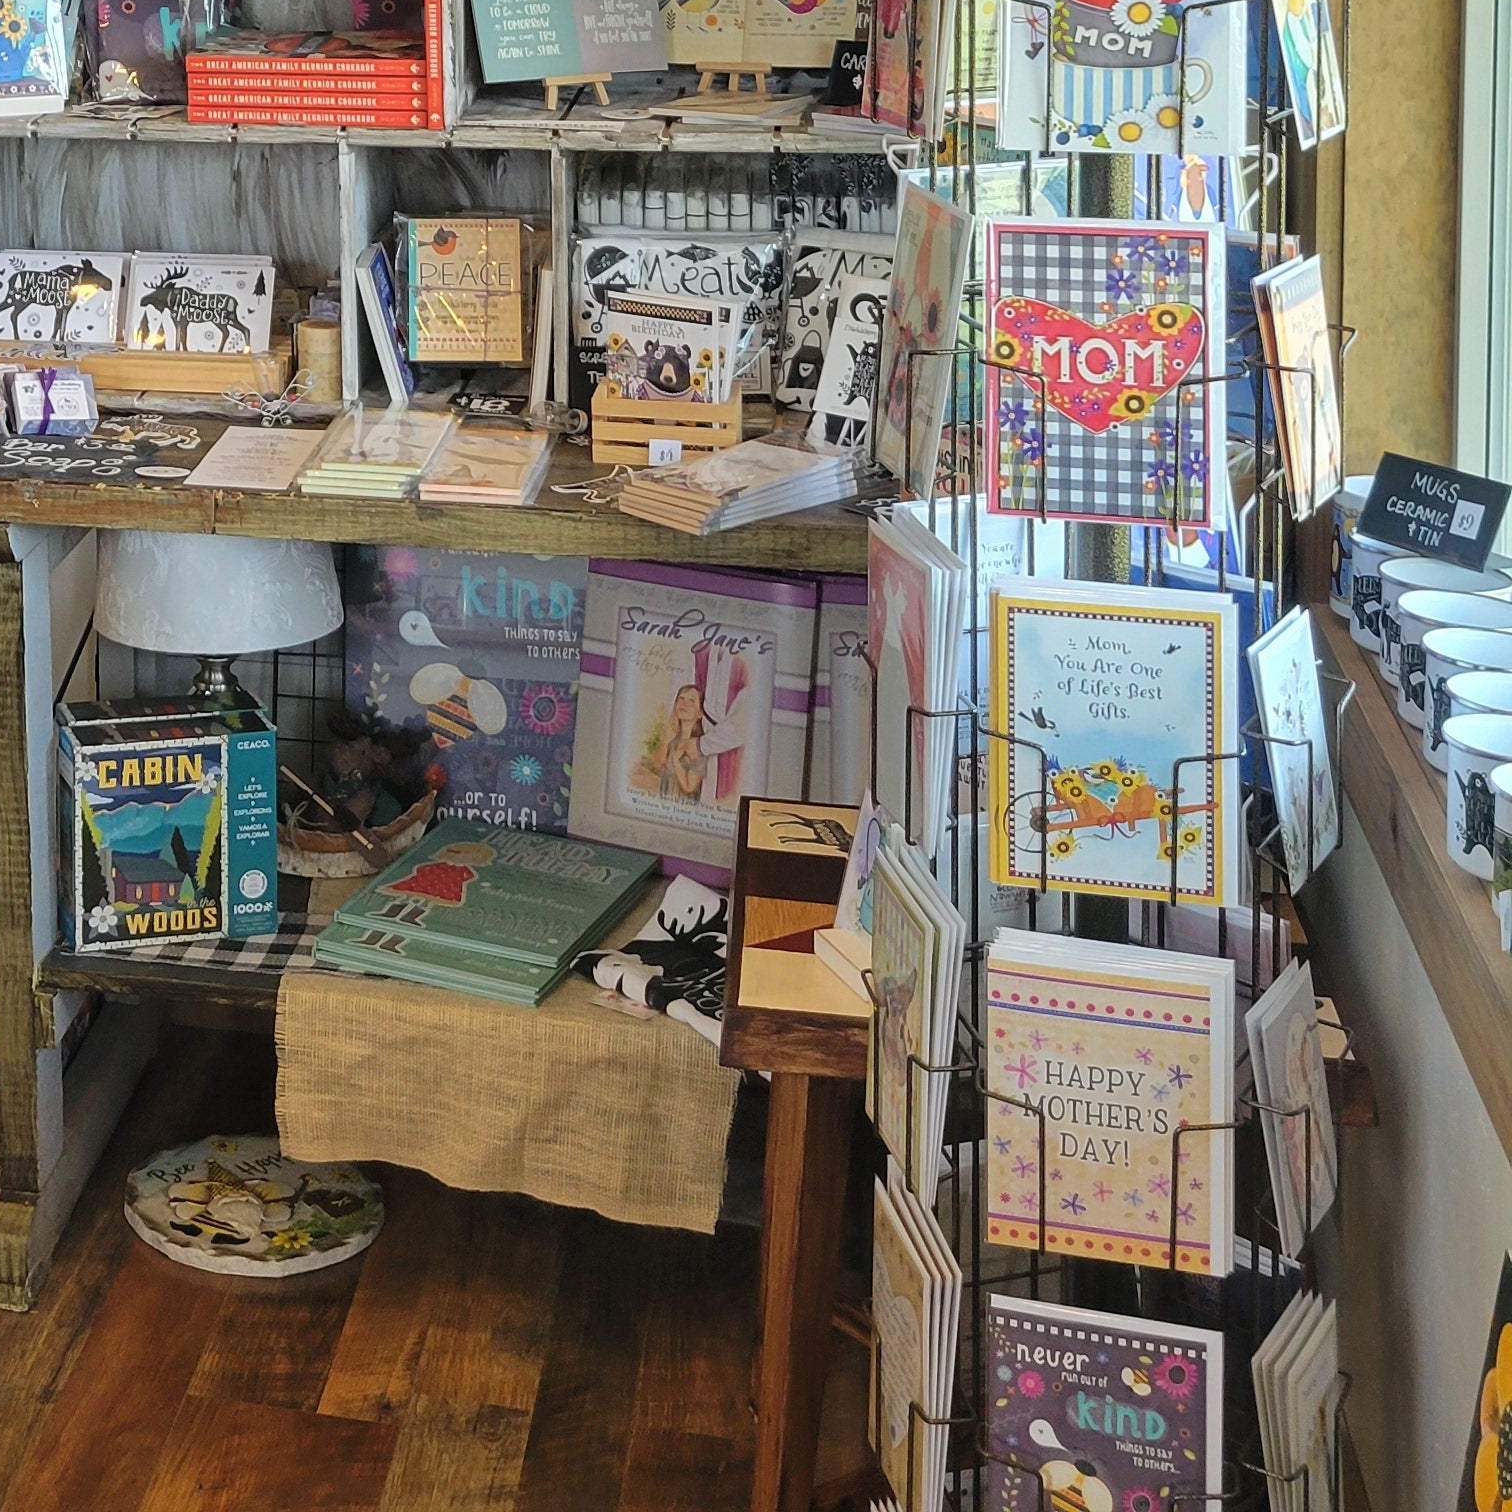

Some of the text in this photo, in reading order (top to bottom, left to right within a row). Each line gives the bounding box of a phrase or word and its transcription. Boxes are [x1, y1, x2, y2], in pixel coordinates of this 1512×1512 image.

[1075, 25, 1153, 58] MOM
[232, 61, 268, 70] AMERICAN
[272, 62, 298, 70] FAMILY
[302, 63, 333, 71] REUNION
[336, 63, 375, 71] COOKBOOK
[420, 262, 512, 286] PEACE
[26, 287, 71, 307] MOOSE
[182, 289, 227, 312] Daddy
[177, 307, 229, 325] MOOSE
[642, 319, 675, 331] HAPPY
[631, 325, 685, 339] BIRTHDAY!
[1032, 336, 1167, 386] MOM
[1, 439, 65, 451] Bar
[1412, 471, 1459, 503] MUGS
[1387, 496, 1449, 527] CERAMIC
[1459, 513, 1474, 530] $9
[1418, 526, 1444, 547] TIN
[621, 607, 774, 655] Sarah Jane's
[1055, 654, 1163, 678] You Are One
[1057, 679, 1163, 700] of Life's Best
[1089, 702, 1130, 720] Gifts.
[98, 754, 203, 789] CABIN
[126, 907, 218, 935] WOODS
[1045, 1060, 1145, 1097] HAPPY
[1023, 1093, 1169, 1134] MOTHER'S
[1060, 1132, 1129, 1166] DAY!
[1017, 1343, 1089, 1374] never
[1061, 1371, 1078, 1384] run
[1145, 1445, 1155, 1456] TO
[1133, 1457, 1142, 1469] TO
